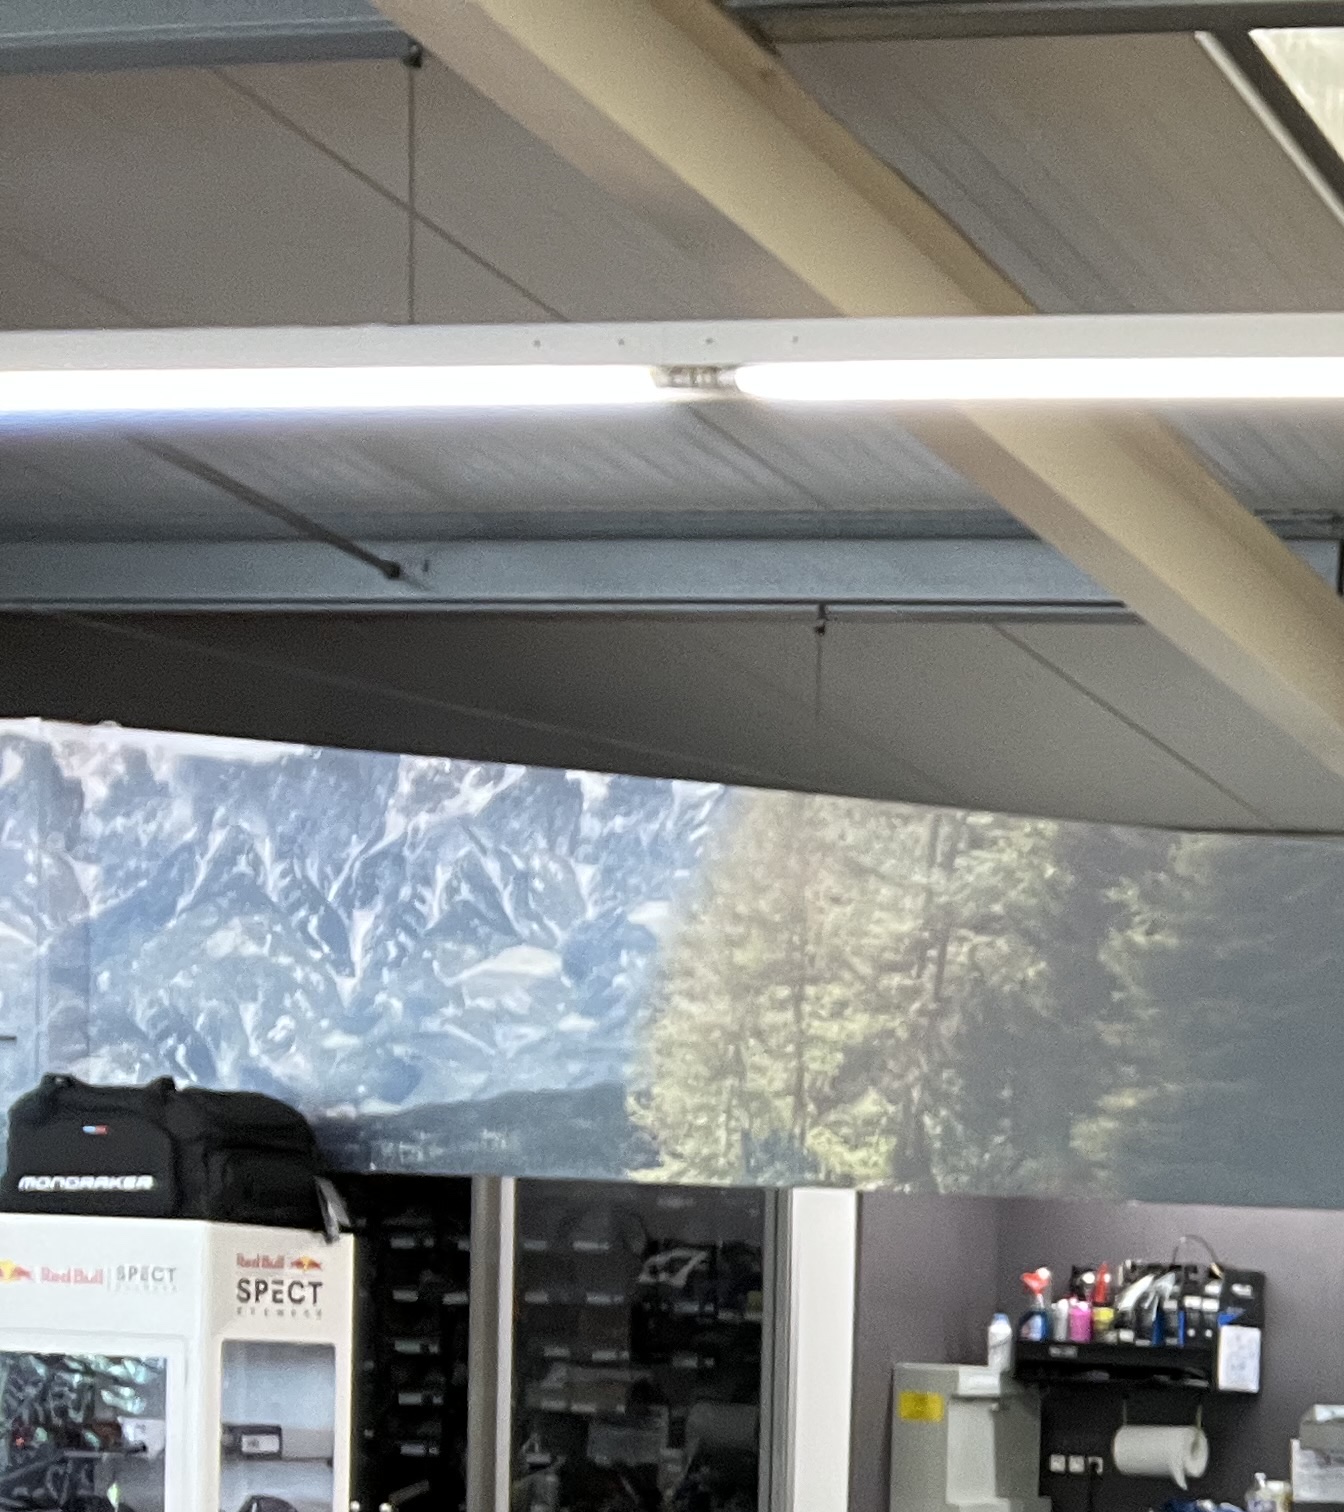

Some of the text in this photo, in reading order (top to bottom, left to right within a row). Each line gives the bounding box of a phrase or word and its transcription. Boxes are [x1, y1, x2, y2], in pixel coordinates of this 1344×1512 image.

[18, 1175, 155, 1192] MONDRAKER
[116, 1265, 177, 1283] SPECT
[237, 1277, 323, 1306] SPECT
